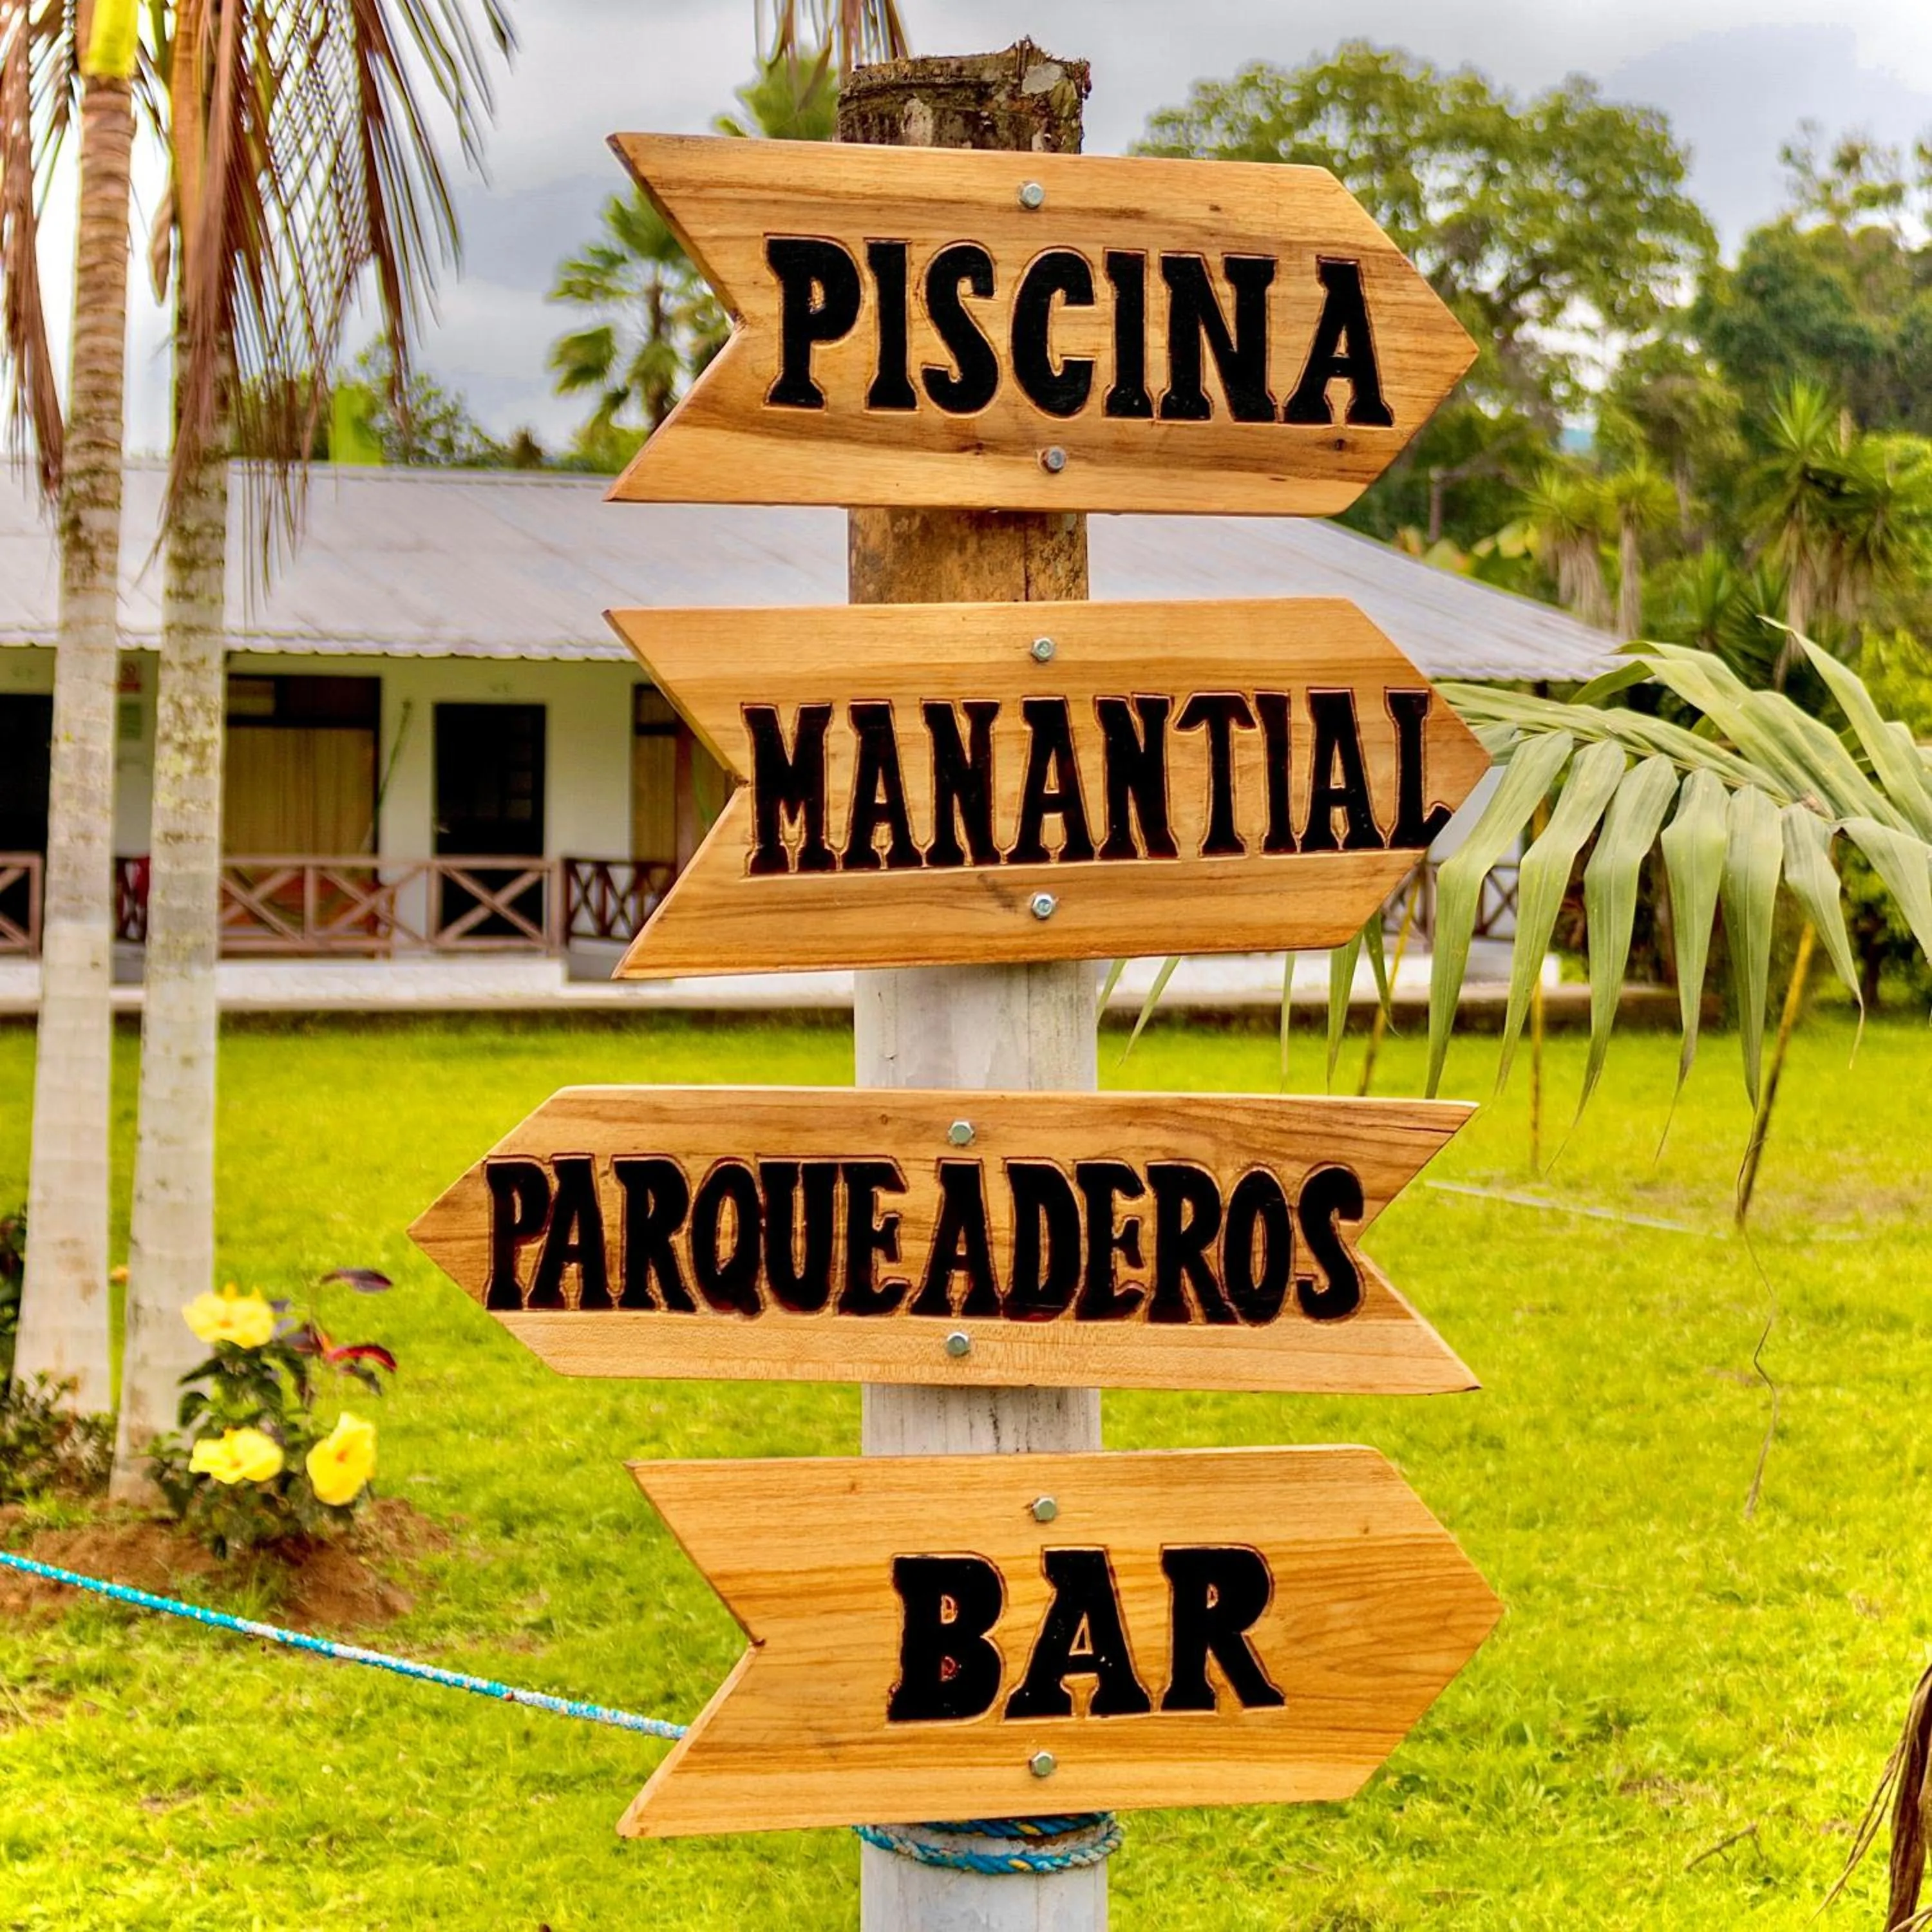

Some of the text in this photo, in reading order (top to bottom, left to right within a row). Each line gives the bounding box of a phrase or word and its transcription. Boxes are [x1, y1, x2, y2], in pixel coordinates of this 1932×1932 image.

[766, 236, 1394, 426] PISCINA
[744, 689, 1454, 876] MANANTIAL
[486, 1157, 1365, 1325] PARQUEADEROS
[889, 1546, 1284, 1721] BAR
